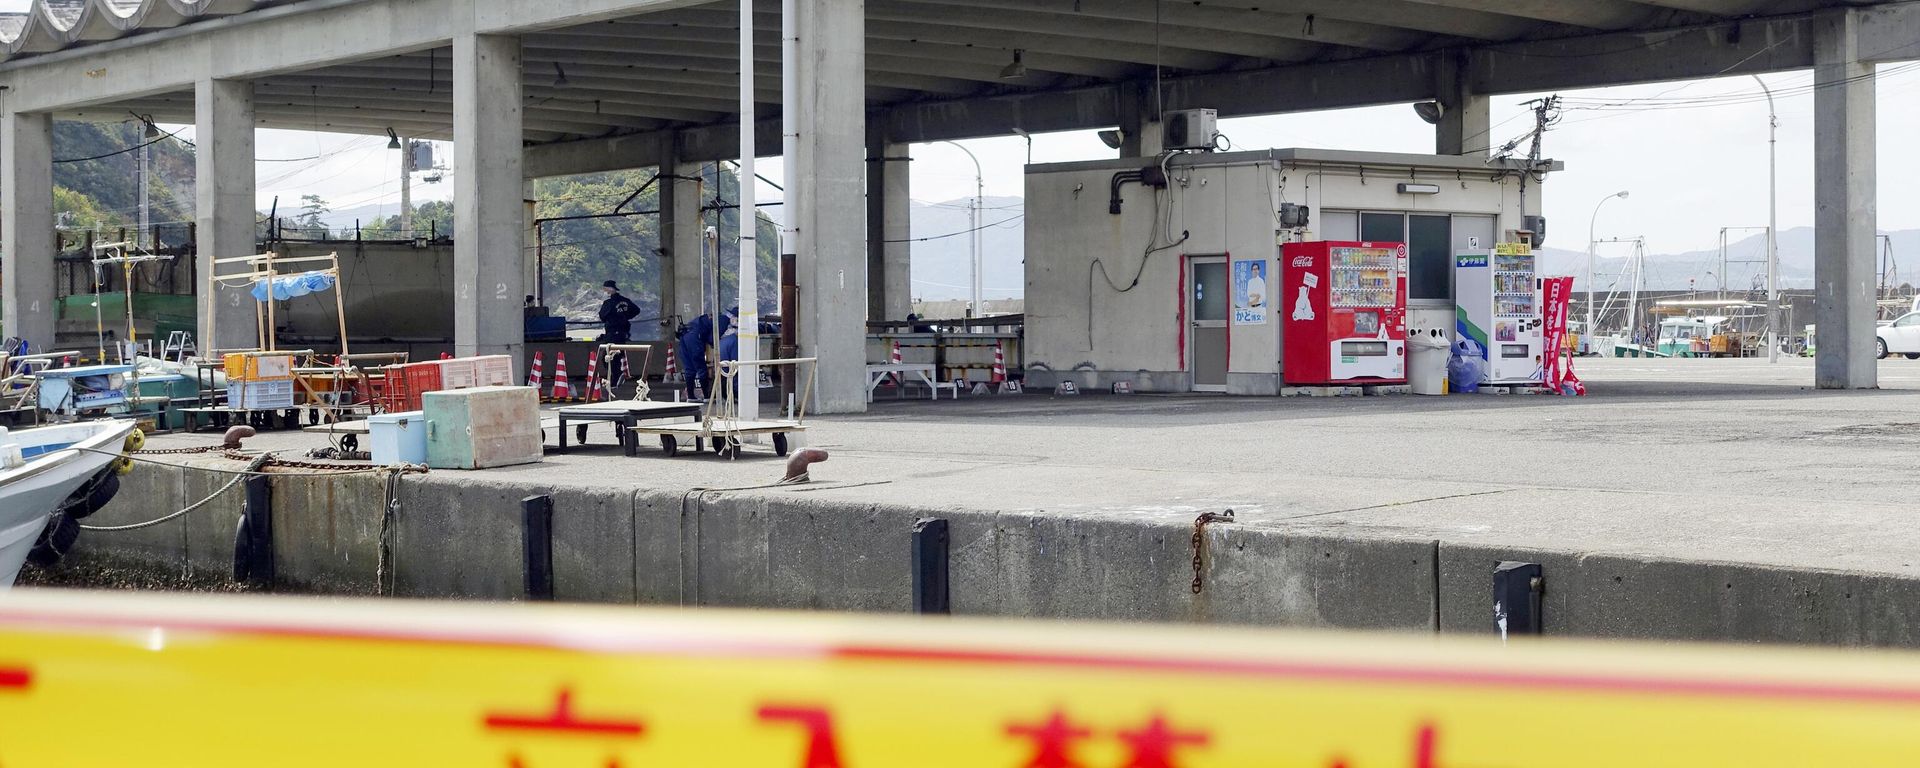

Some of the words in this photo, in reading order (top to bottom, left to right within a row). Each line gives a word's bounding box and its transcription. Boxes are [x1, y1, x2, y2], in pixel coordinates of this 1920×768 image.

[1292, 255, 1314, 268] Coca-Cola
[496, 282, 507, 299] 2
[30, 299, 40, 313] 4
[1065, 382, 1074, 391] 20
